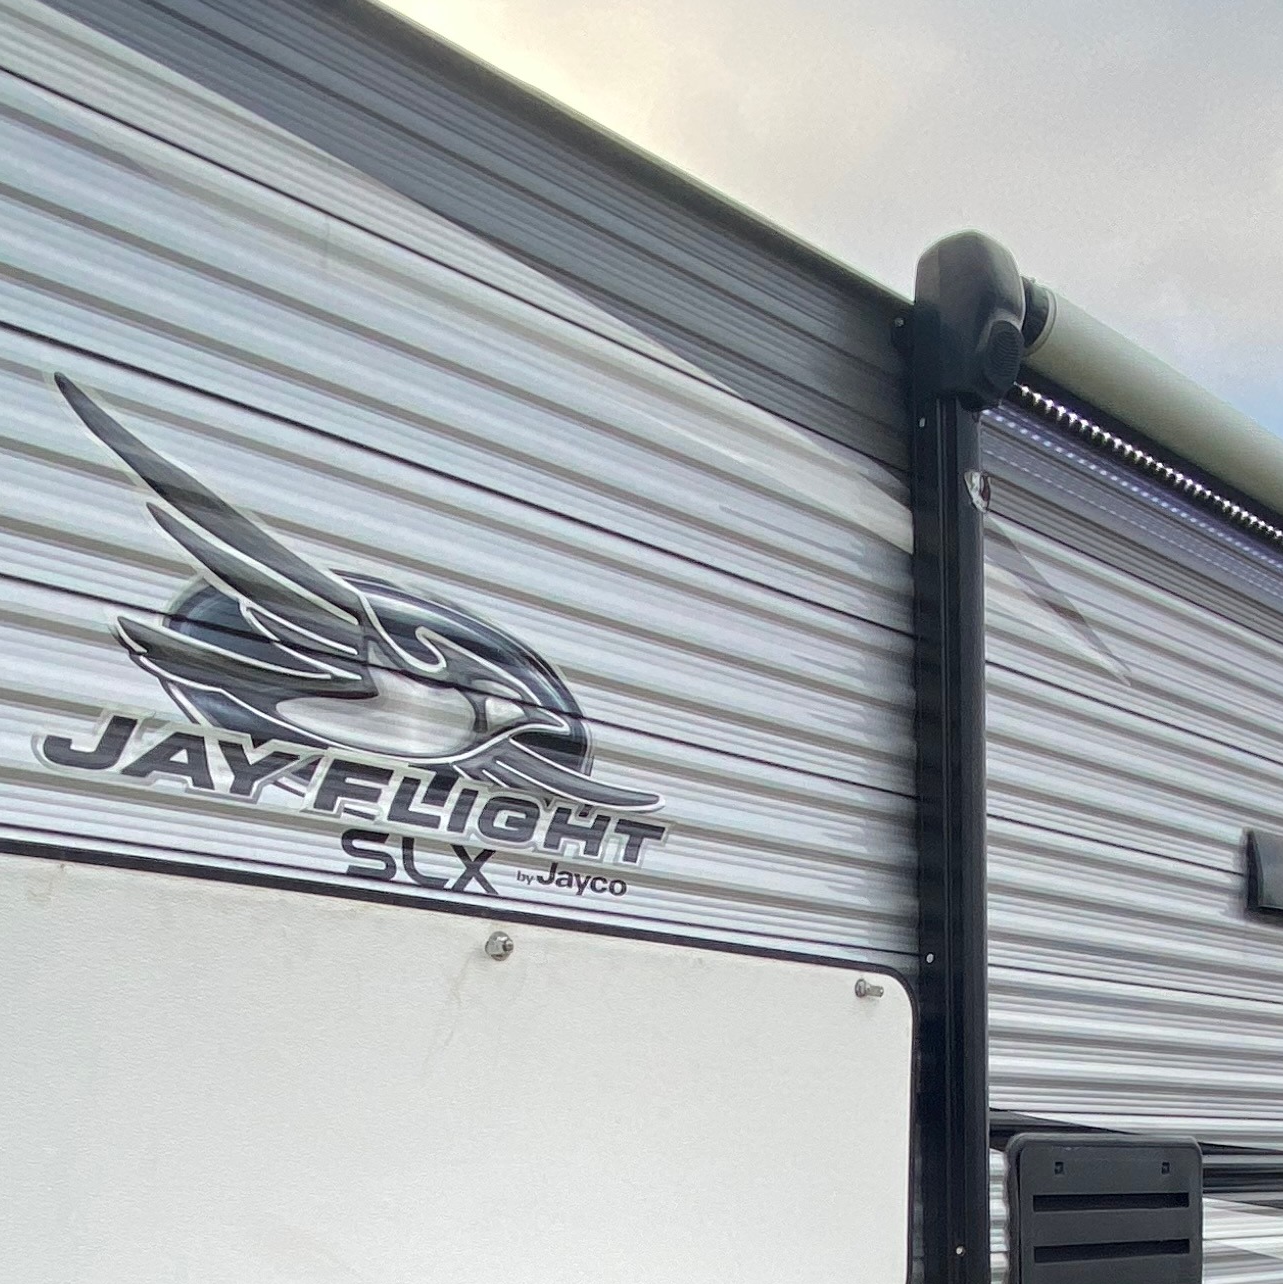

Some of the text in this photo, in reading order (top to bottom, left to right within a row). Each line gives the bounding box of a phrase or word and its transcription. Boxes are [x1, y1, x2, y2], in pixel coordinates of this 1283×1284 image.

[41, 714, 667, 865] JAY FLIGHT
[340, 828, 500, 896] SLX
[517, 862, 627, 896] by Jayco
